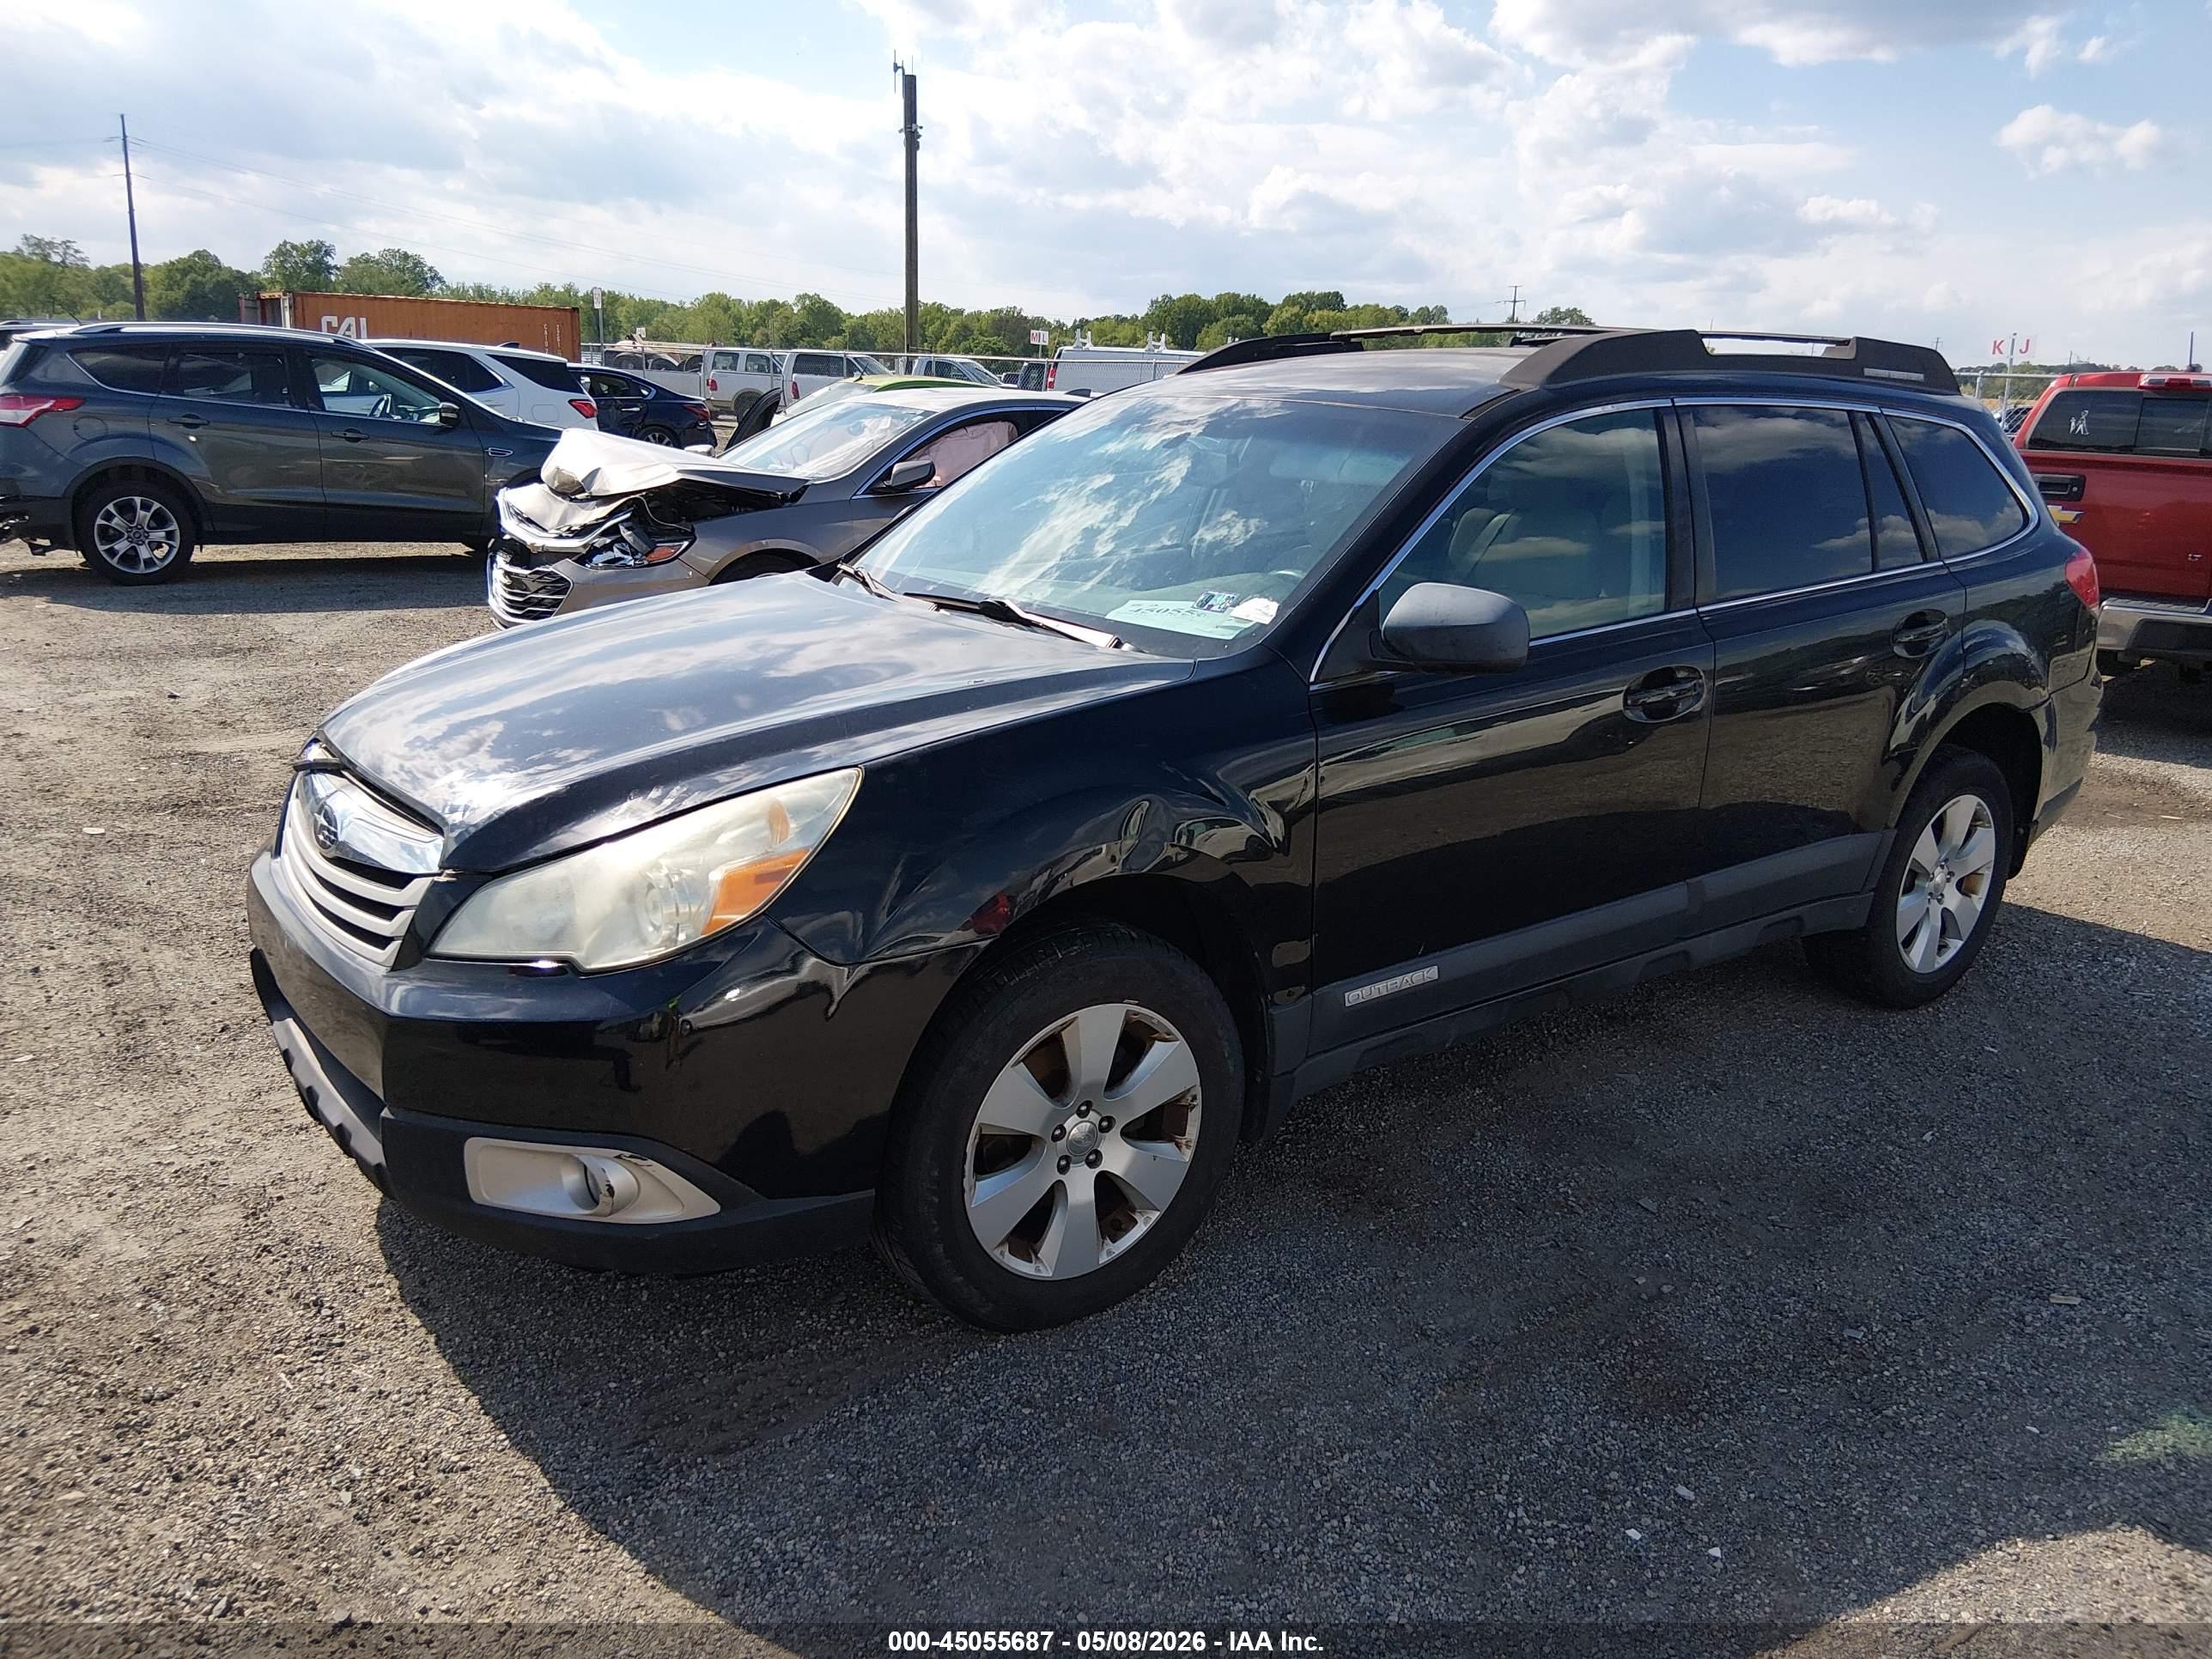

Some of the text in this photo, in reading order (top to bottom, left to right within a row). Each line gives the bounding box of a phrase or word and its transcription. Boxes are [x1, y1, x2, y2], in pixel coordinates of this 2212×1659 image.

[1992, 338, 2030, 355] K J
[1346, 967, 1437, 1004] OUTBACK
